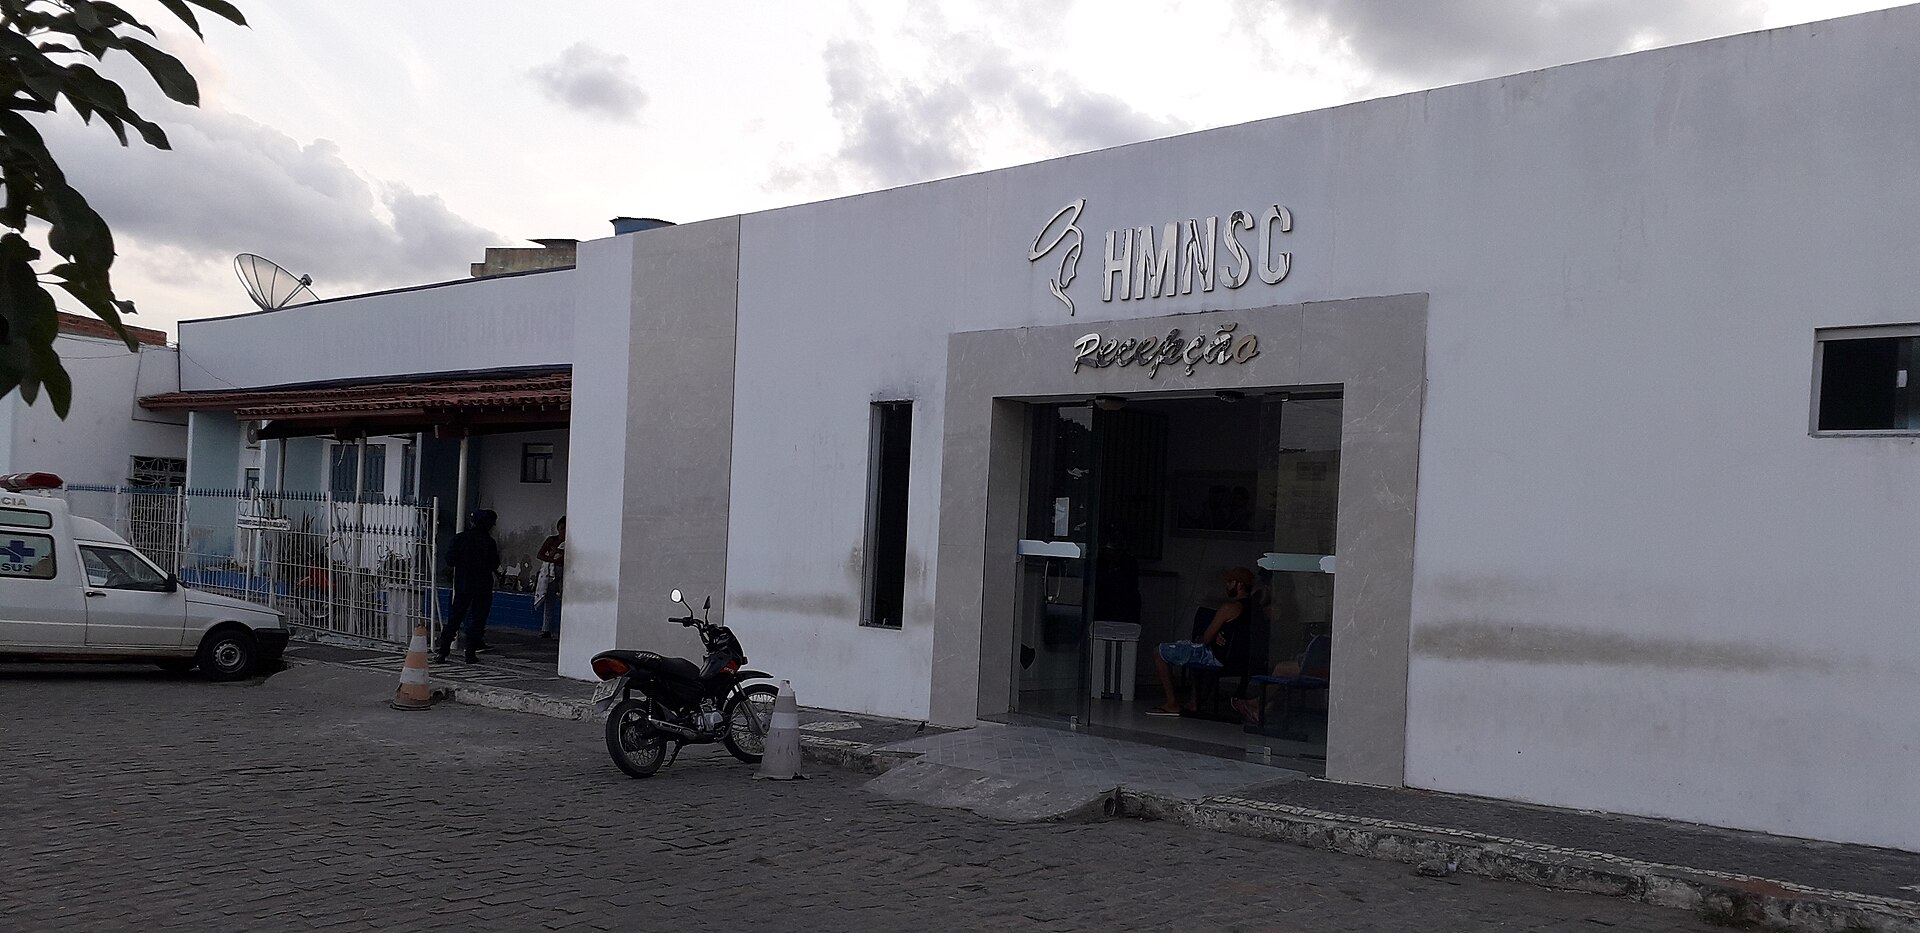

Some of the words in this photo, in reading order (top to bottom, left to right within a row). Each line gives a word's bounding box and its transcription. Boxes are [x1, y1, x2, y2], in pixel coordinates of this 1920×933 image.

[1102, 204, 1293, 302] HMNSC
[1073, 322, 1261, 379] Recepção
[1, 563, 32, 573] SUS
